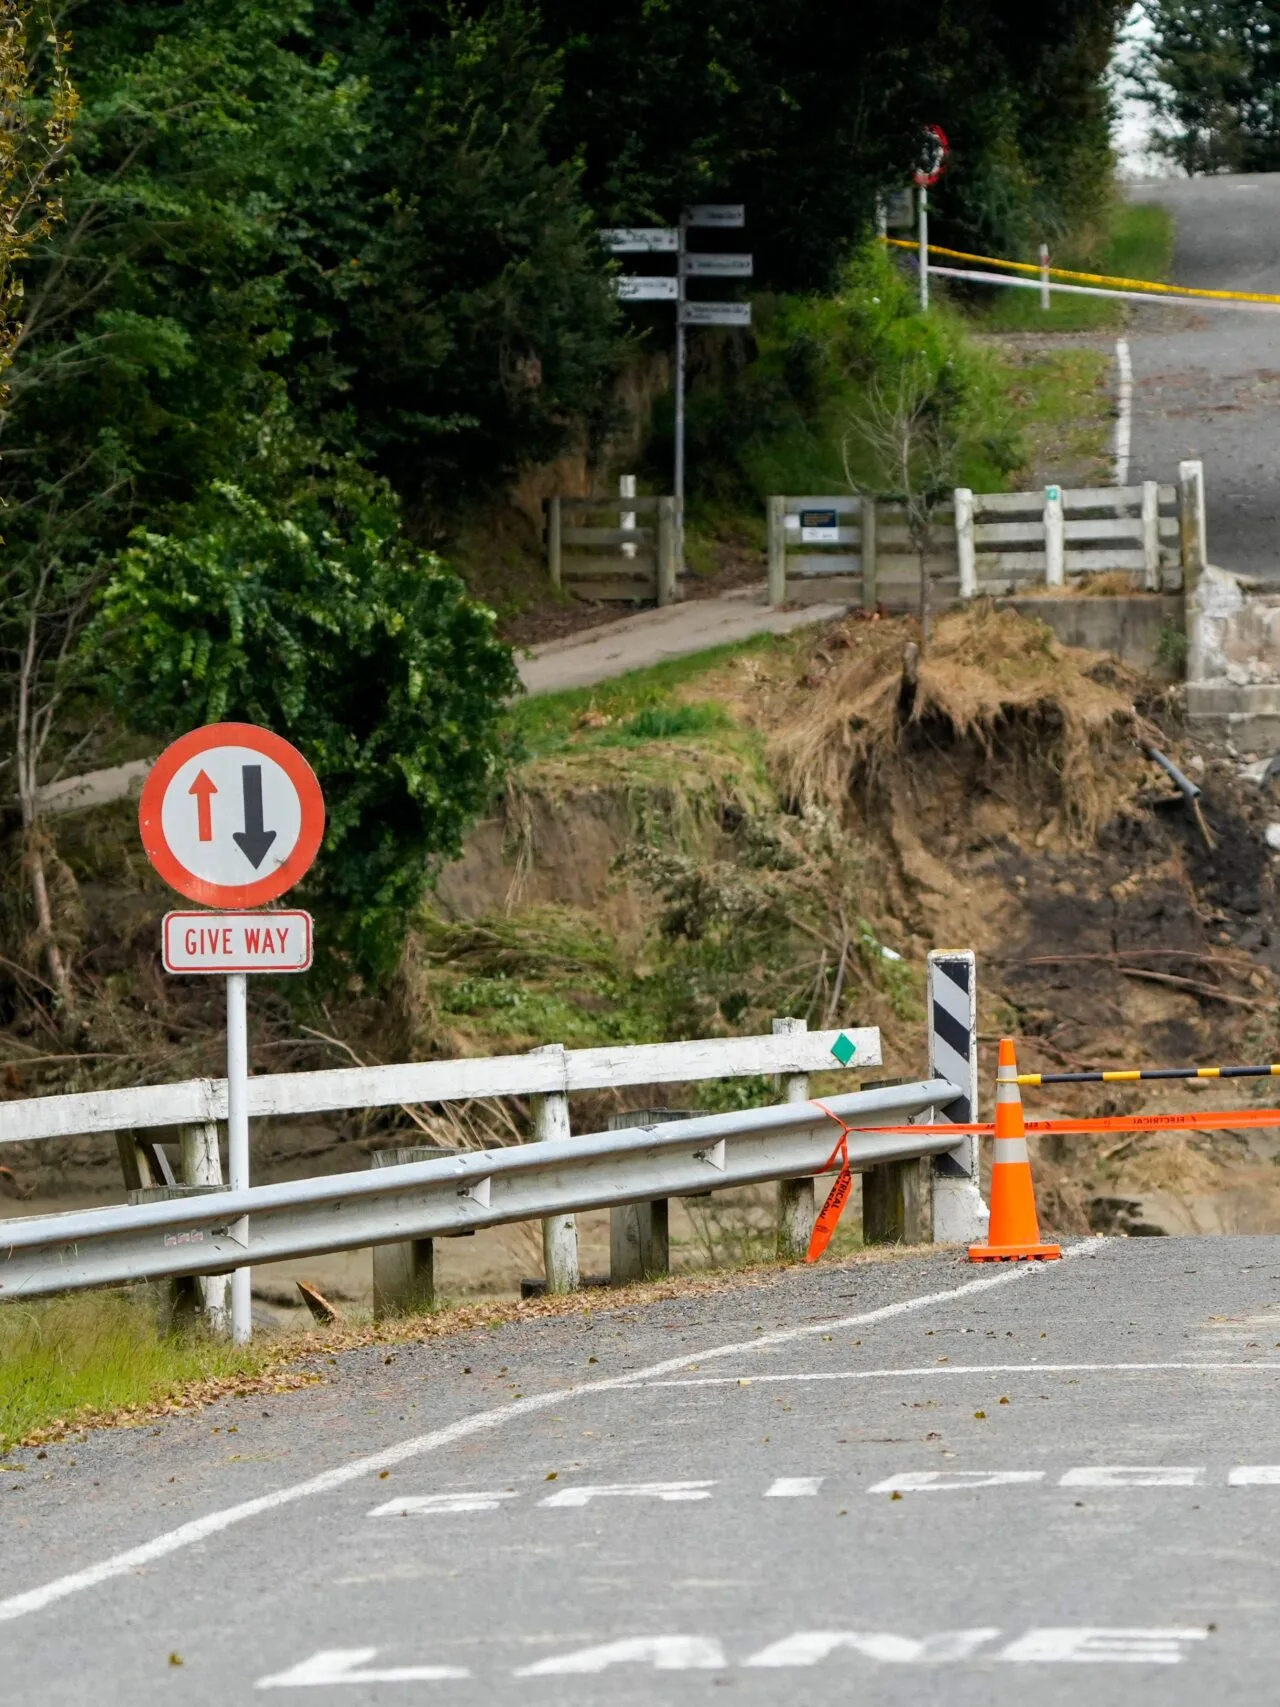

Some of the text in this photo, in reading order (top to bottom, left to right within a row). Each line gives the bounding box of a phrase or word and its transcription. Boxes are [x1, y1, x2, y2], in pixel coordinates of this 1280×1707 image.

[185, 928, 289, 955] GIVE WAY
[256, 1626, 1209, 1689] LANE
